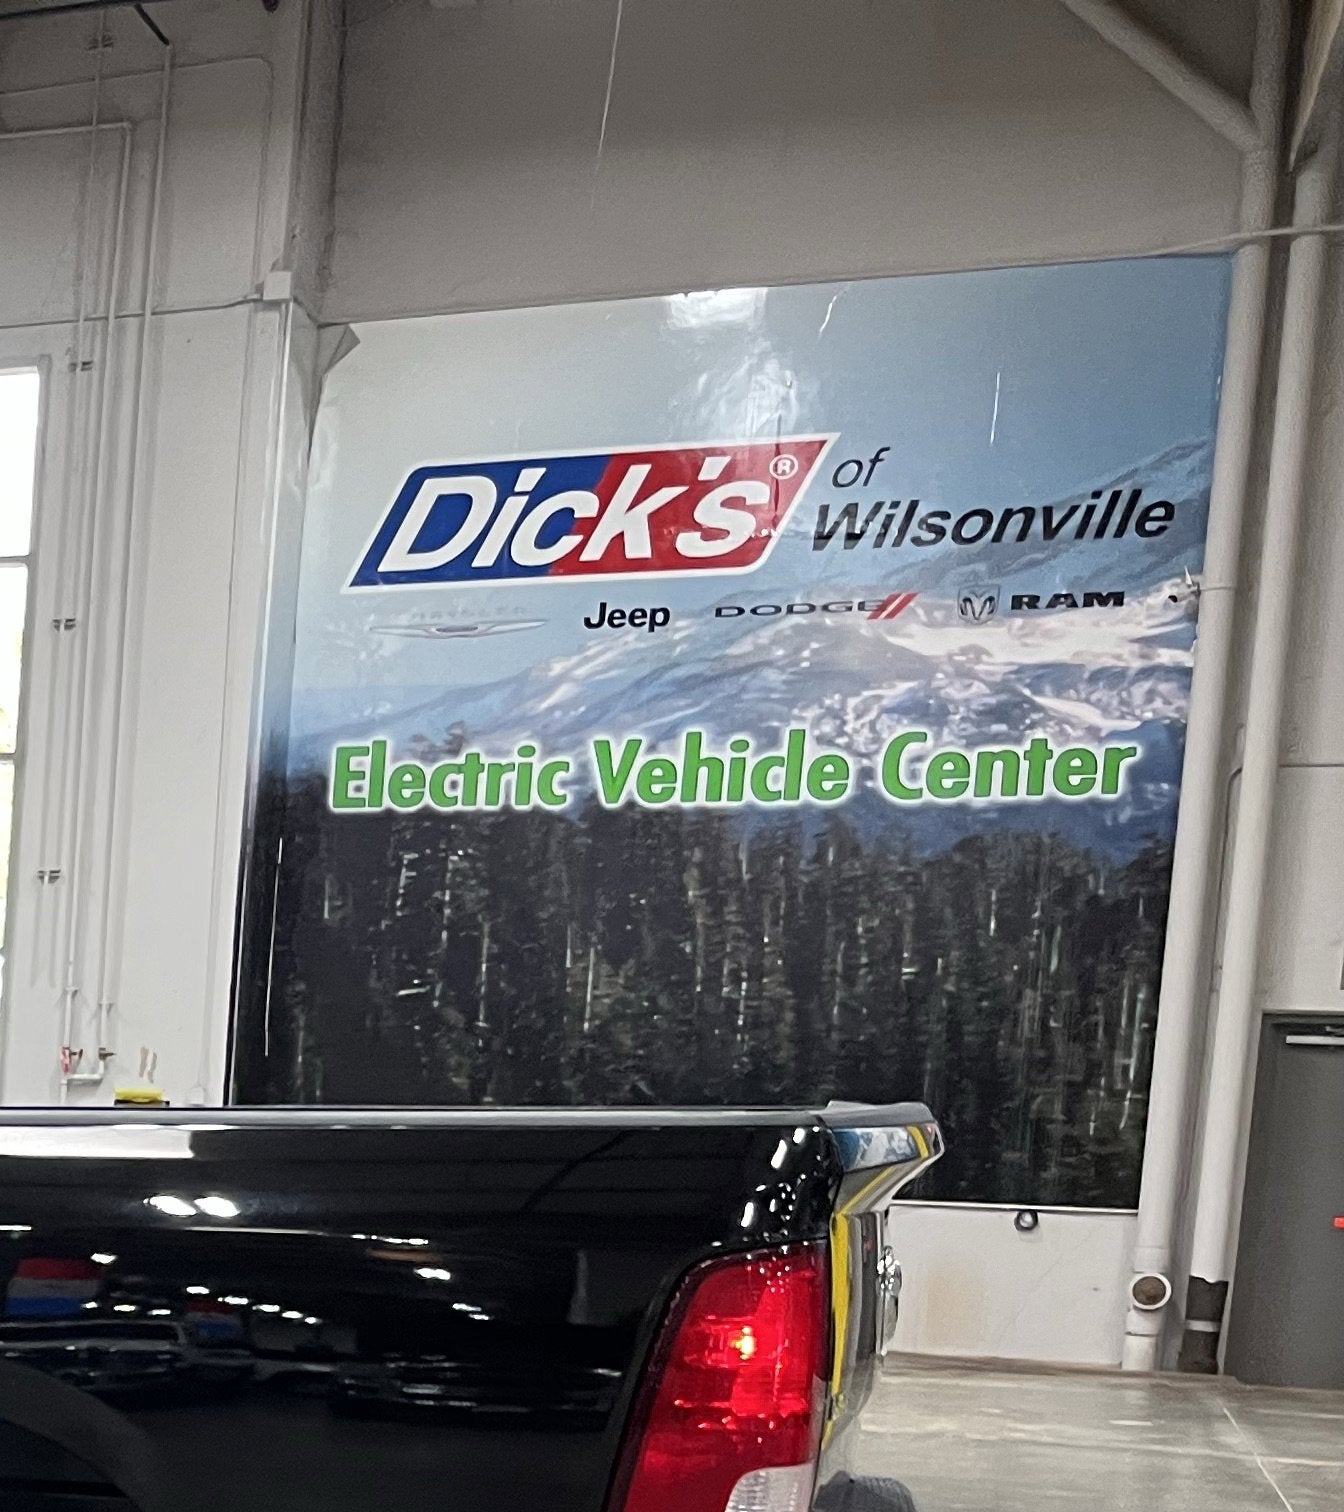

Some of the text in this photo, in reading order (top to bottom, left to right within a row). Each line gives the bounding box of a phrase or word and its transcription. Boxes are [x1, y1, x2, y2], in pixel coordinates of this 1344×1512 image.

[831, 446, 890, 488] of
[812, 488, 1175, 551] Wilsonville
[583, 602, 671, 632] Jeep
[1011, 590, 1126, 611] RAM
[332, 729, 1137, 809] Electric Vehicle Center
